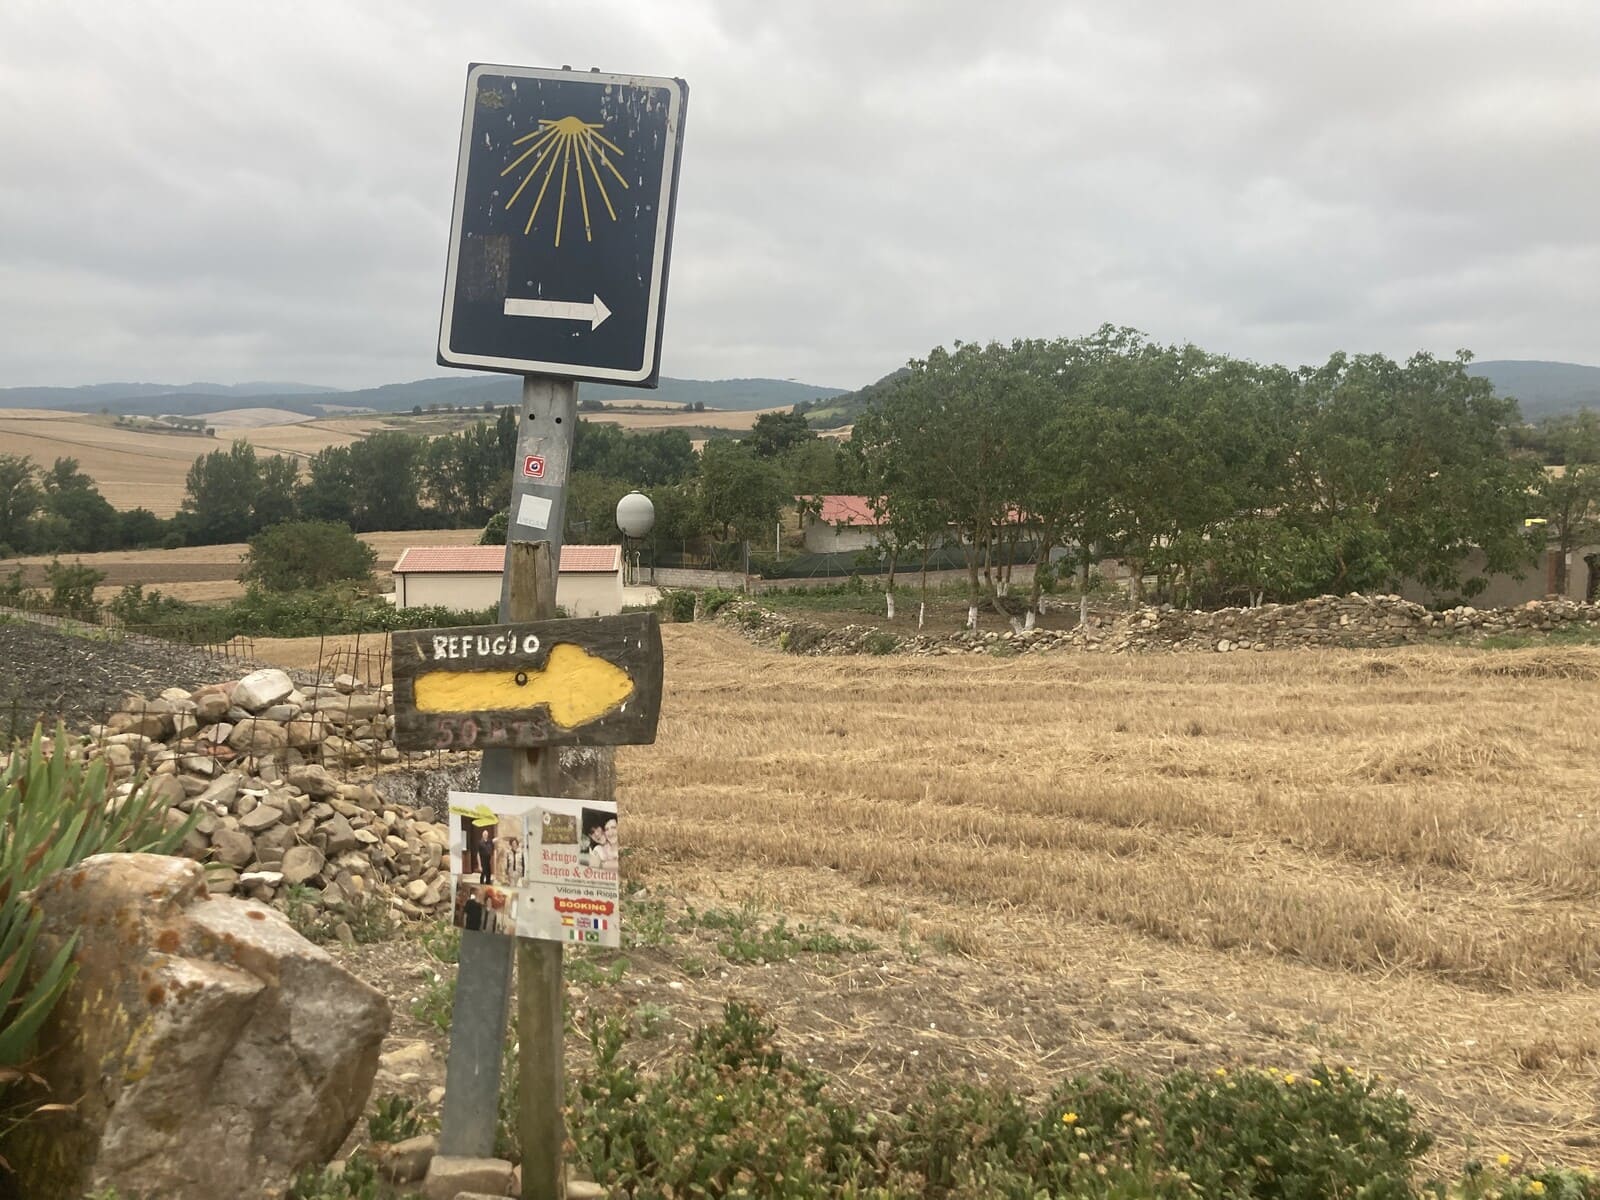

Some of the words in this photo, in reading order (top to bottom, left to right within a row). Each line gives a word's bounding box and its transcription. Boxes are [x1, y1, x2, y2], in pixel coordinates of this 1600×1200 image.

[436, 718, 478, 747] 50
[542, 849, 577, 864] Refugio
[572, 866, 582, 878] &
[583, 866, 617, 881] Orietta
[584, 888, 594, 896] de
[597, 890, 618, 899] Rioja
[559, 900, 607, 911] BOOKING
